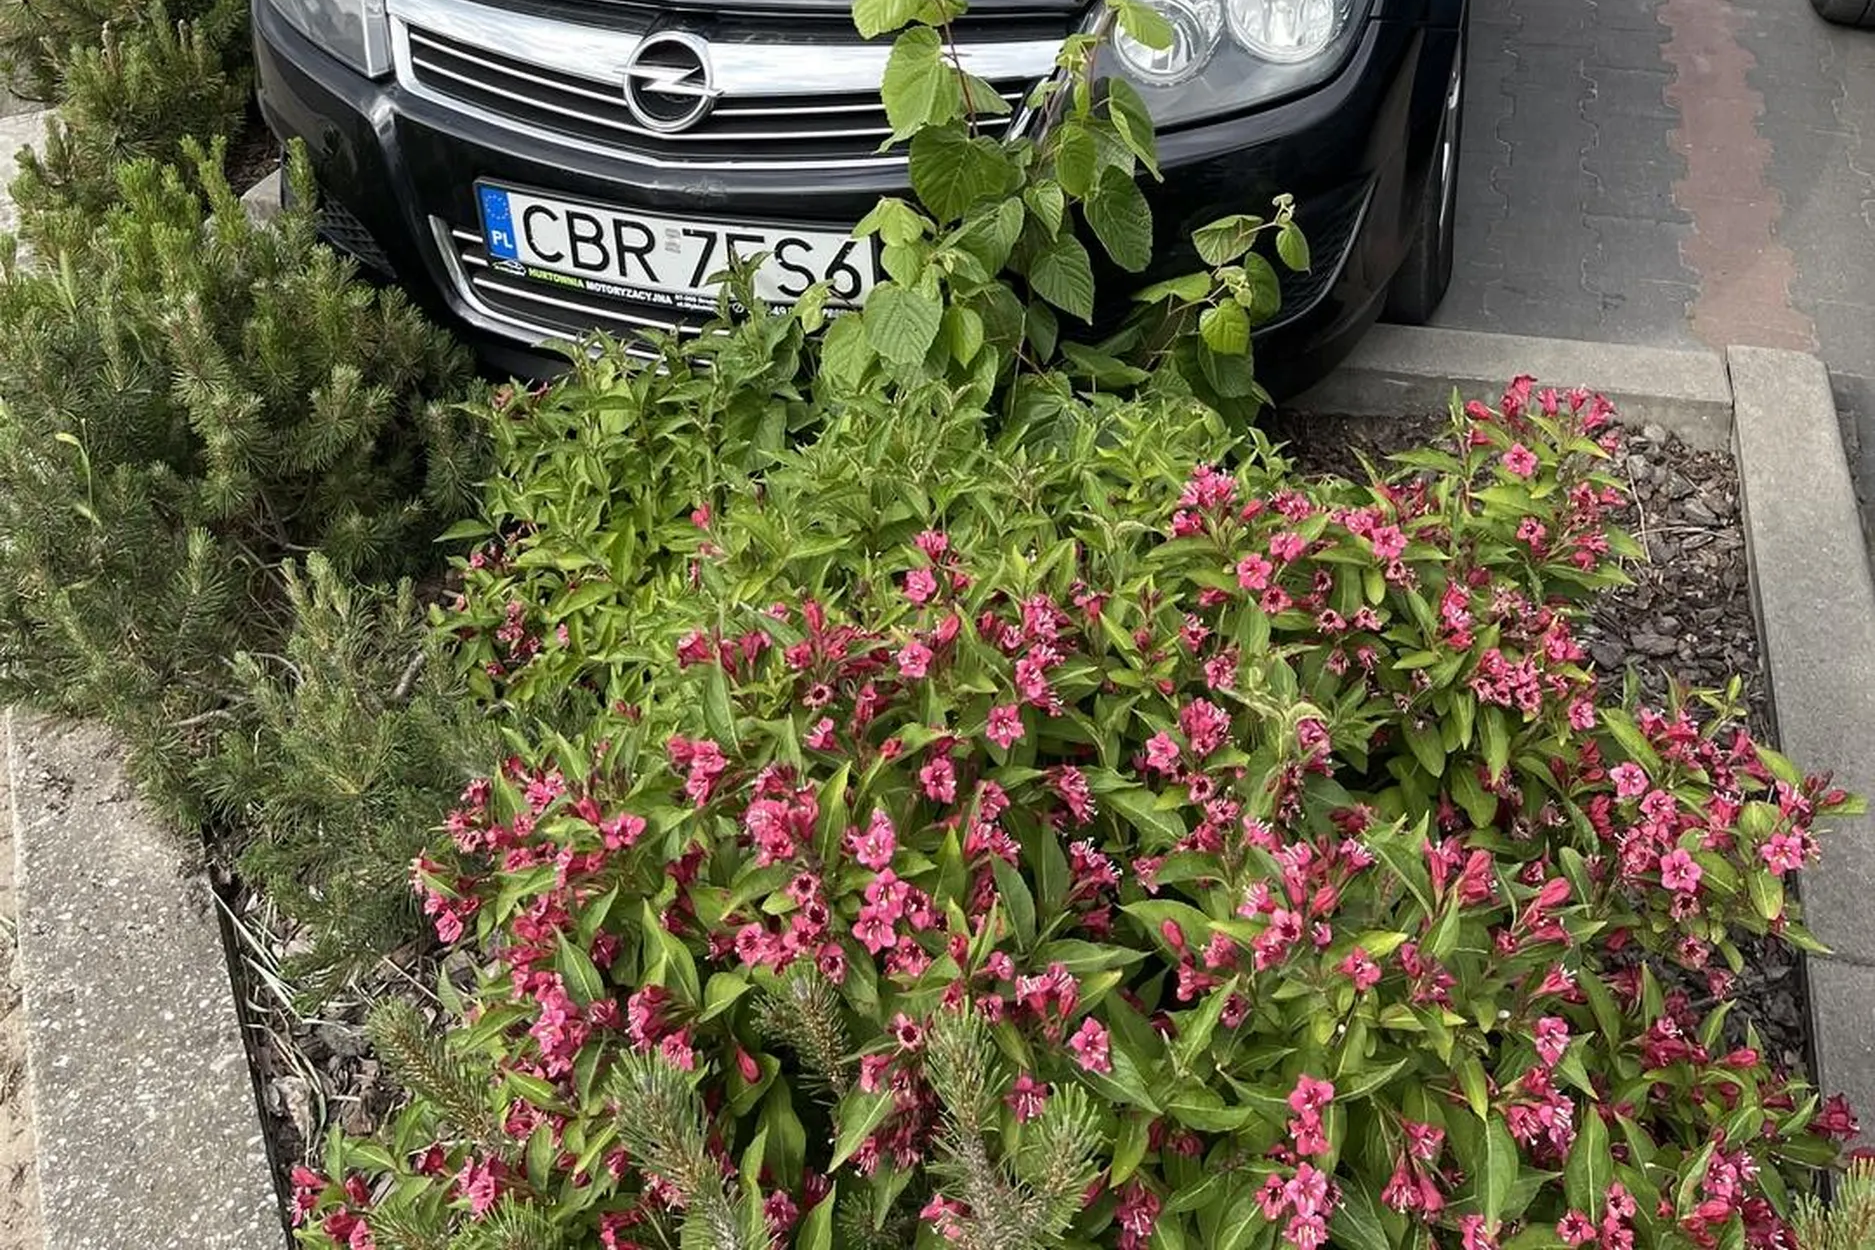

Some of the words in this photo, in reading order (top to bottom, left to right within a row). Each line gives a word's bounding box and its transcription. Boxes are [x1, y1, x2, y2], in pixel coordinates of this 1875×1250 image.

[491, 230, 513, 249] PL
[522, 205, 661, 283] CBR
[528, 267, 585, 289] HURTOWNIA
[586, 280, 673, 305] MOTORYZACYJNA
